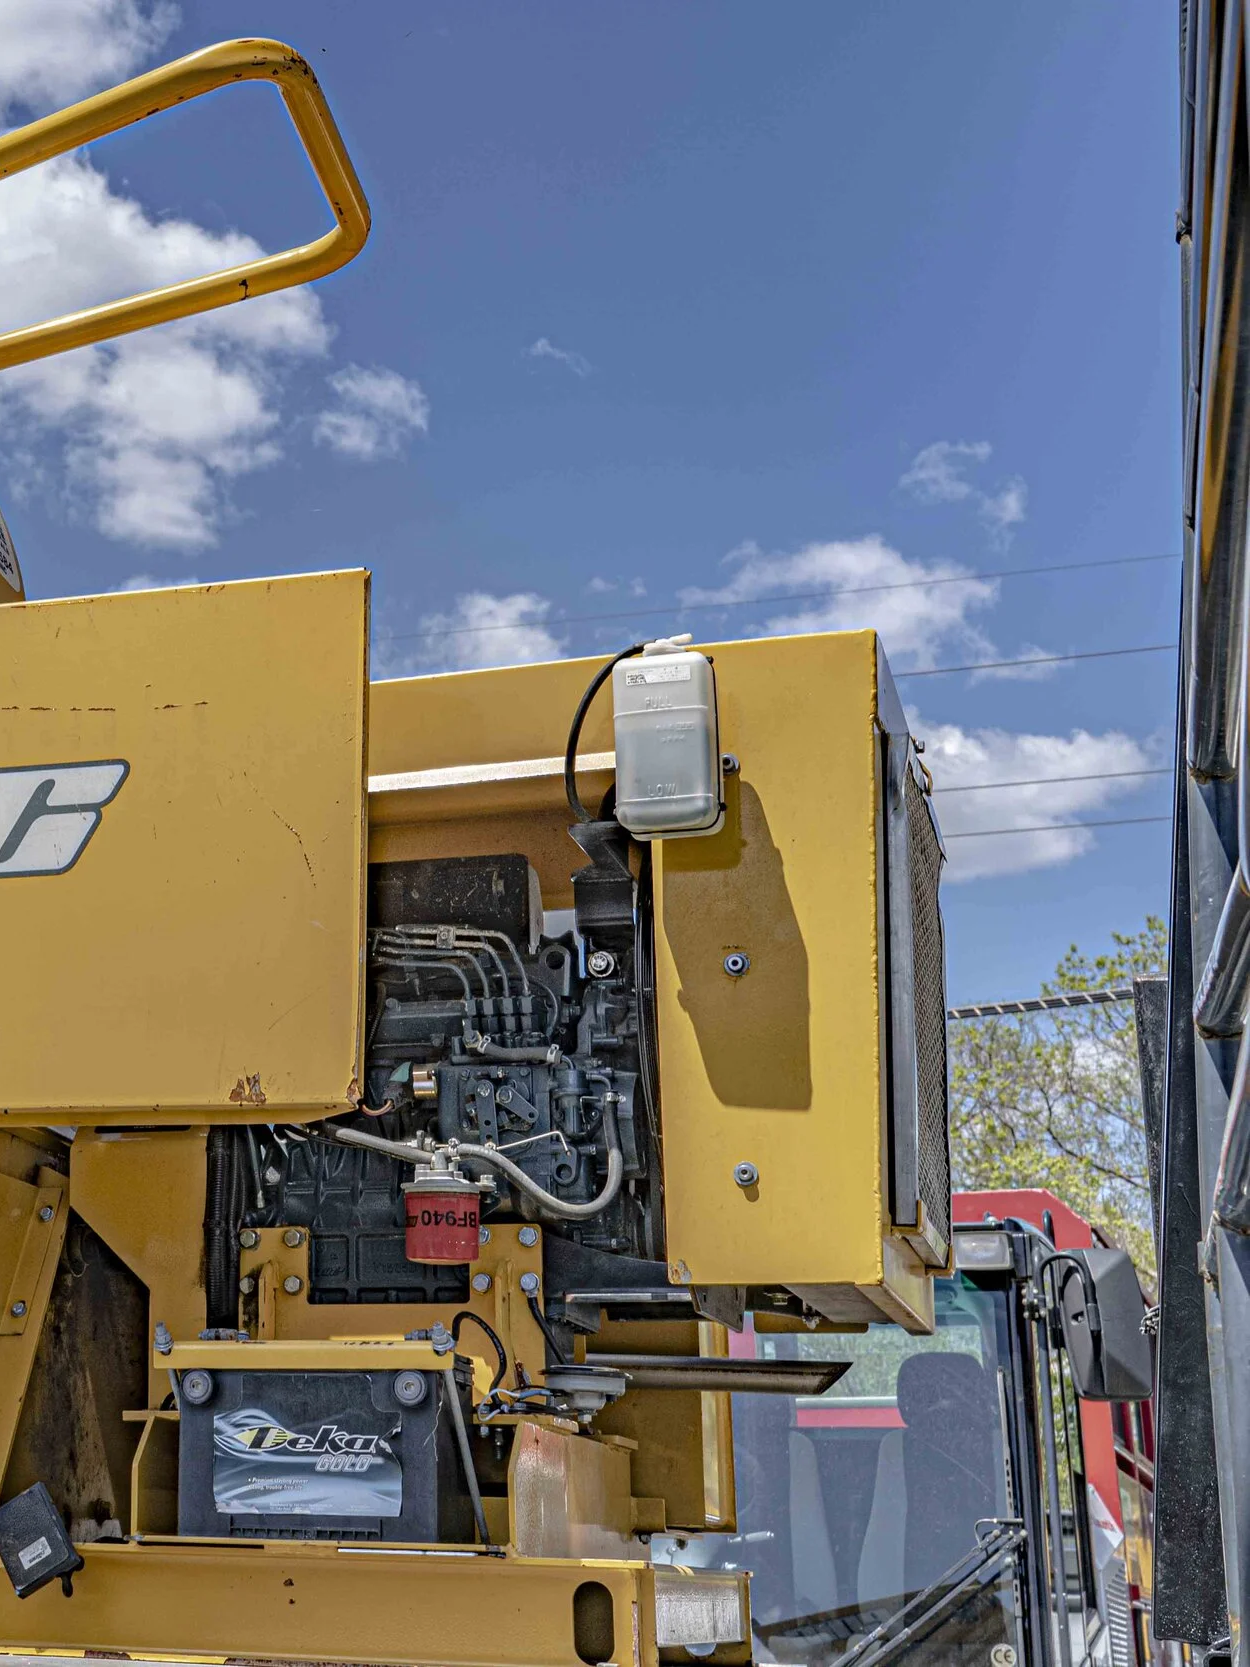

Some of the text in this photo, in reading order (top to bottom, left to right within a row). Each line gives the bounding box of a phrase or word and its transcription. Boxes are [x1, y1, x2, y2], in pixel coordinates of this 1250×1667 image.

[647, 783, 676, 797] LOW
[245, 1424, 379, 1455] Deka
[315, 1454, 374, 1472] GOLD
